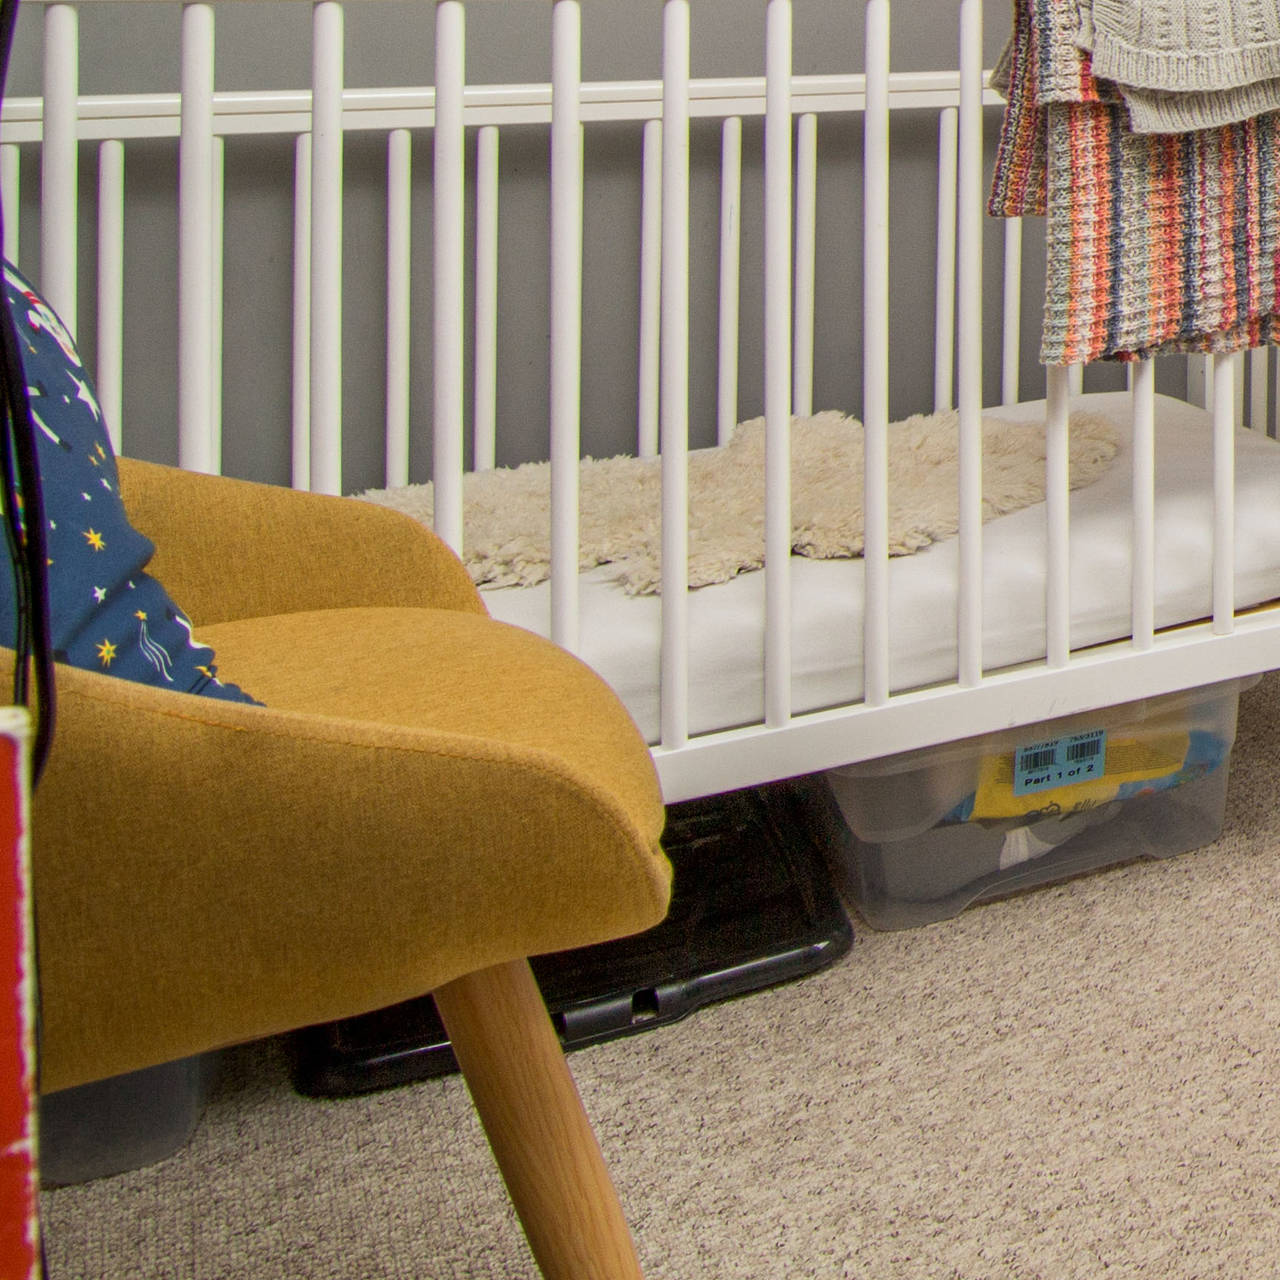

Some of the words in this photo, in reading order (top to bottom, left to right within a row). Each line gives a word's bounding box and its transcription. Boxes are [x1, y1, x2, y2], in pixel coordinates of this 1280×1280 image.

[1024, 774, 1051, 786] Part
[1057, 771, 1063, 779] 1
[1068, 767, 1081, 777] of
[1086, 764, 1094, 773] 2
